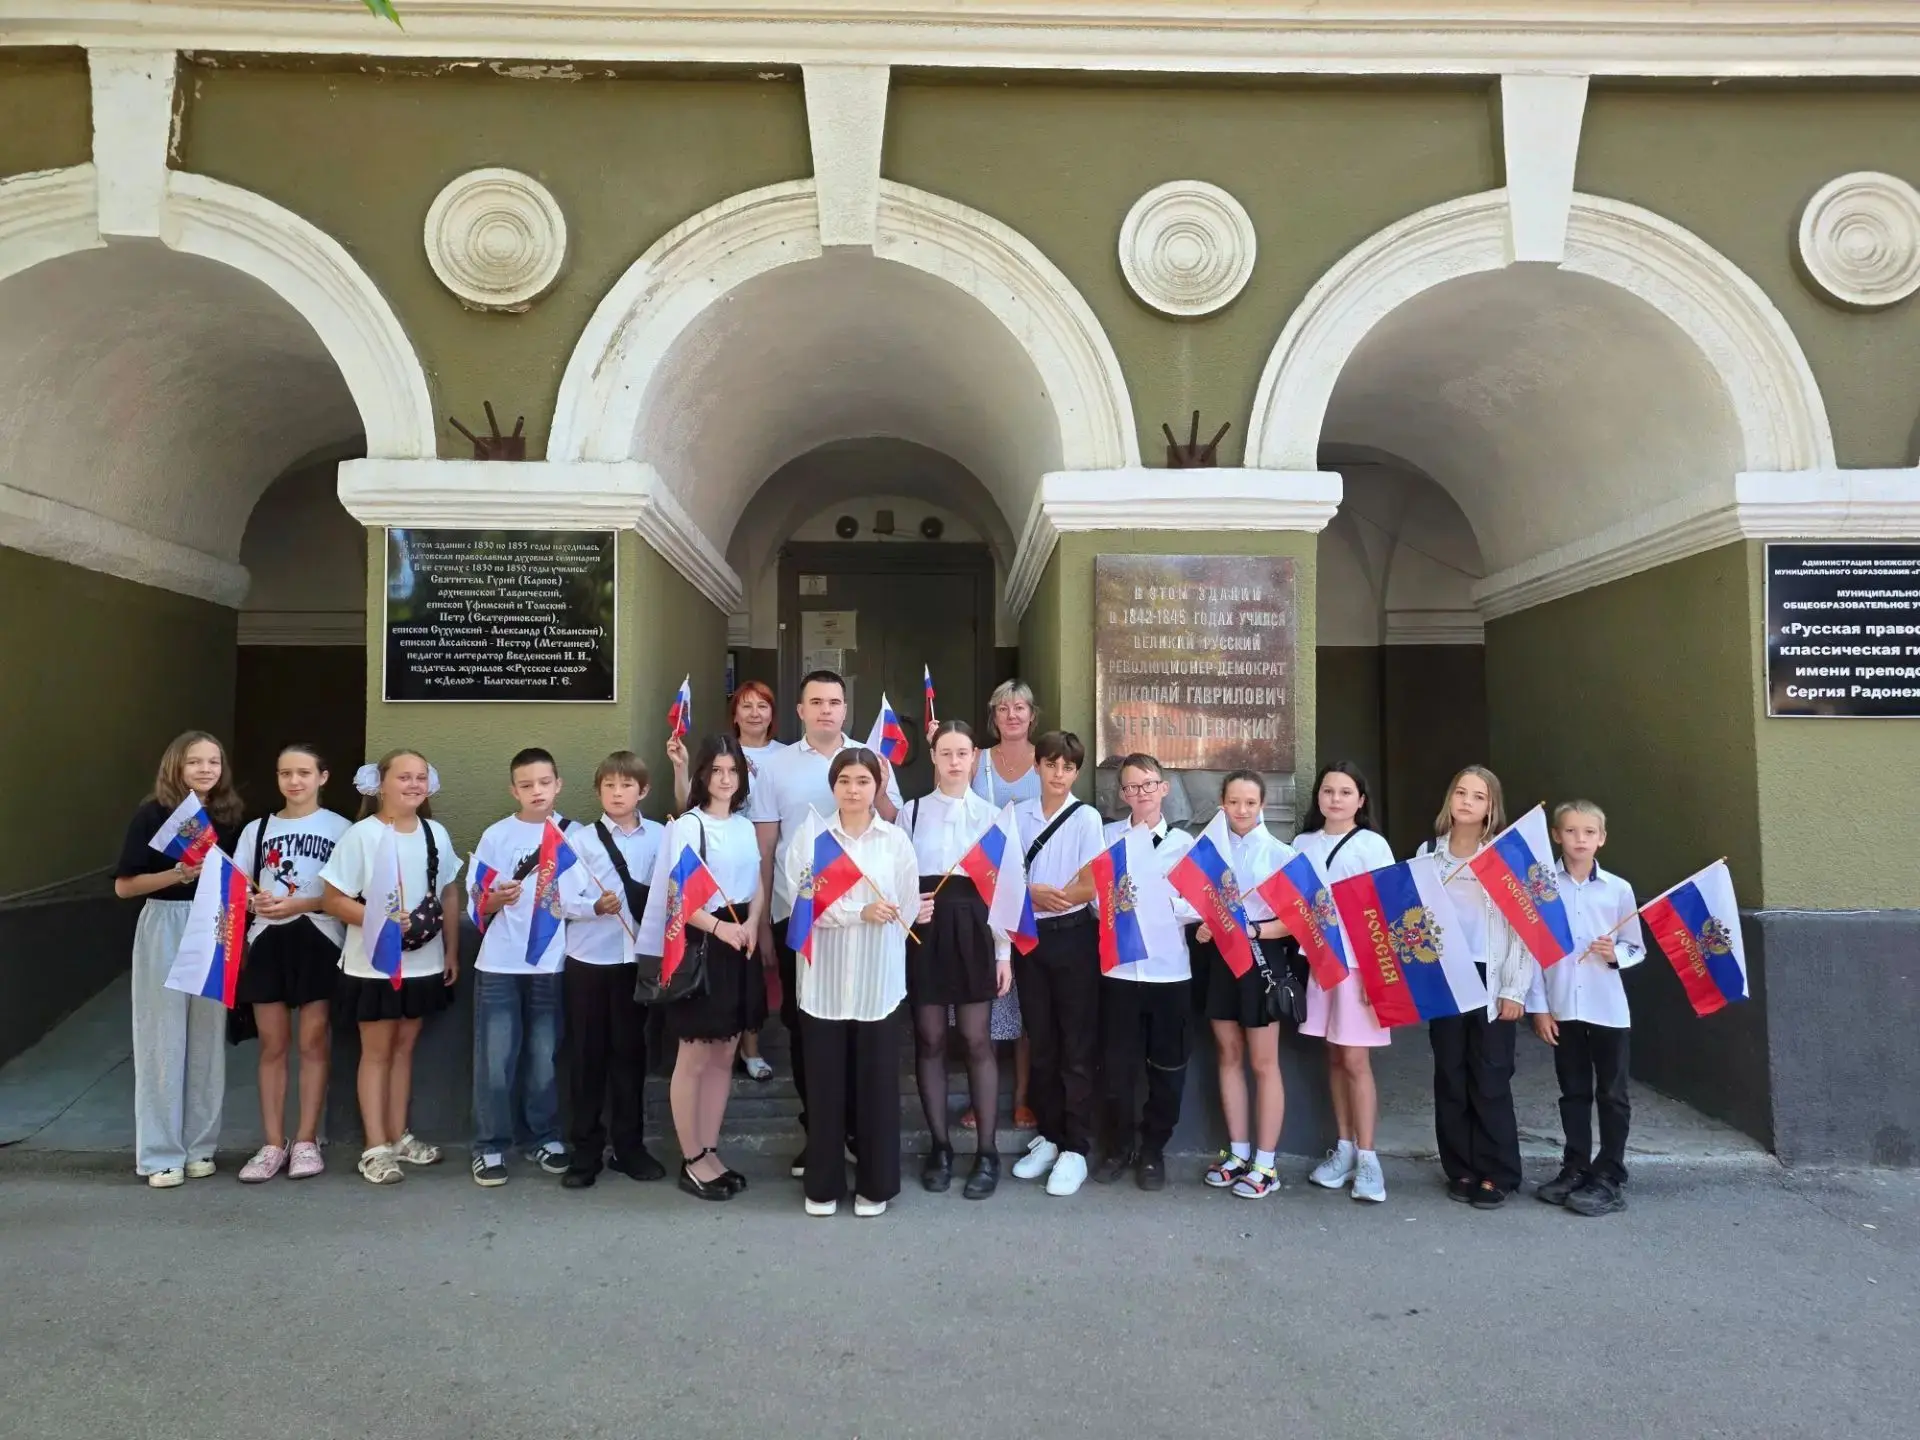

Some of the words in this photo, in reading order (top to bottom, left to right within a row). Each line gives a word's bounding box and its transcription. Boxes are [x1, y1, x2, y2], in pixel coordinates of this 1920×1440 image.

[434, 542, 465, 550] здании
[474, 541, 494, 549] 1830
[508, 541, 528, 550] 1855
[530, 543, 551, 551] годы
[552, 543, 600, 552] находилась
[455, 553, 513, 562] православная
[514, 555, 554, 563] духовная
[556, 555, 600, 563] семинария
[434, 564, 464, 573] стенах
[472, 563, 492, 571] 1830
[507, 564, 526, 572] 1850
[528, 565, 549, 573] годы
[1774, 568, 1851, 576] МУНИЦИПАЛЬНОГО
[430, 574, 484, 584] Святитель
[487, 575, 515, 587] Гурий
[518, 574, 563, 587] (Карпов)
[438, 589, 496, 598] архиепископ
[498, 588, 562, 599] Таврический,
[1134, 587, 1143, 600] В
[1150, 586, 1188, 600] ЭТОМ
[1198, 587, 1262, 602] ЗДАНИИ
[1837, 590, 1920, 598] МУНИЦИПАЛЬНО
[465, 600, 515, 611] Уфимский
[525, 601, 567, 610] Томский
[1783, 602, 1910, 610] ОБЩЕОБРАЗОВАТЕЛЬНОЕ
[440, 612, 465, 623] Петр
[468, 612, 560, 624] (Екатериновский),
[1123, 608, 1186, 625] 1842-1845
[1194, 611, 1233, 626] ГОДАХ
[1239, 611, 1286, 627] УЧИЛСЯ
[392, 626, 429, 634] епископ
[431, 625, 482, 636] Сухумский
[491, 626, 540, 636] Александр
[543, 625, 607, 637] (Хованский),
[1781, 623, 1861, 637] «Русская
[400, 639, 436, 647] епископ
[438, 638, 487, 647] Аксайский
[496, 638, 531, 649] Нестор
[1134, 632, 1194, 649] ВЕЛИКИЙ
[1204, 633, 1261, 650] РУССКИЙ
[453, 653, 504, 662] литератор
[506, 651, 562, 661] Введенский
[564, 652, 575, 660] И.
[1780, 646, 1900, 656] классическая
[410, 665, 456, 673] издатель
[458, 666, 503, 674] журналов
[505, 664, 552, 675] «Русское
[553, 665, 588, 673] слово»
[1795, 667, 1850, 677] имени
[434, 675, 475, 686] «Дело»
[484, 676, 548, 686] Благосветлов
[550, 676, 560, 685] Г.
[1108, 681, 1180, 704] НИКОЛАЙ
[1187, 685, 1287, 706] ГАВРИЛОВИЧ
[1786, 685, 1846, 700] Сергия
[1113, 713, 1281, 740] ЧЕРНЫШЕВСКИЙ
[1501, 873, 1539, 924] РОССИЯ
[1203, 884, 1235, 933] РОССИЯ
[1293, 899, 1325, 949] РОССИЯ
[1363, 908, 1400, 985] РОССИЯ
[1674, 929, 1706, 978] РОССИЯ
